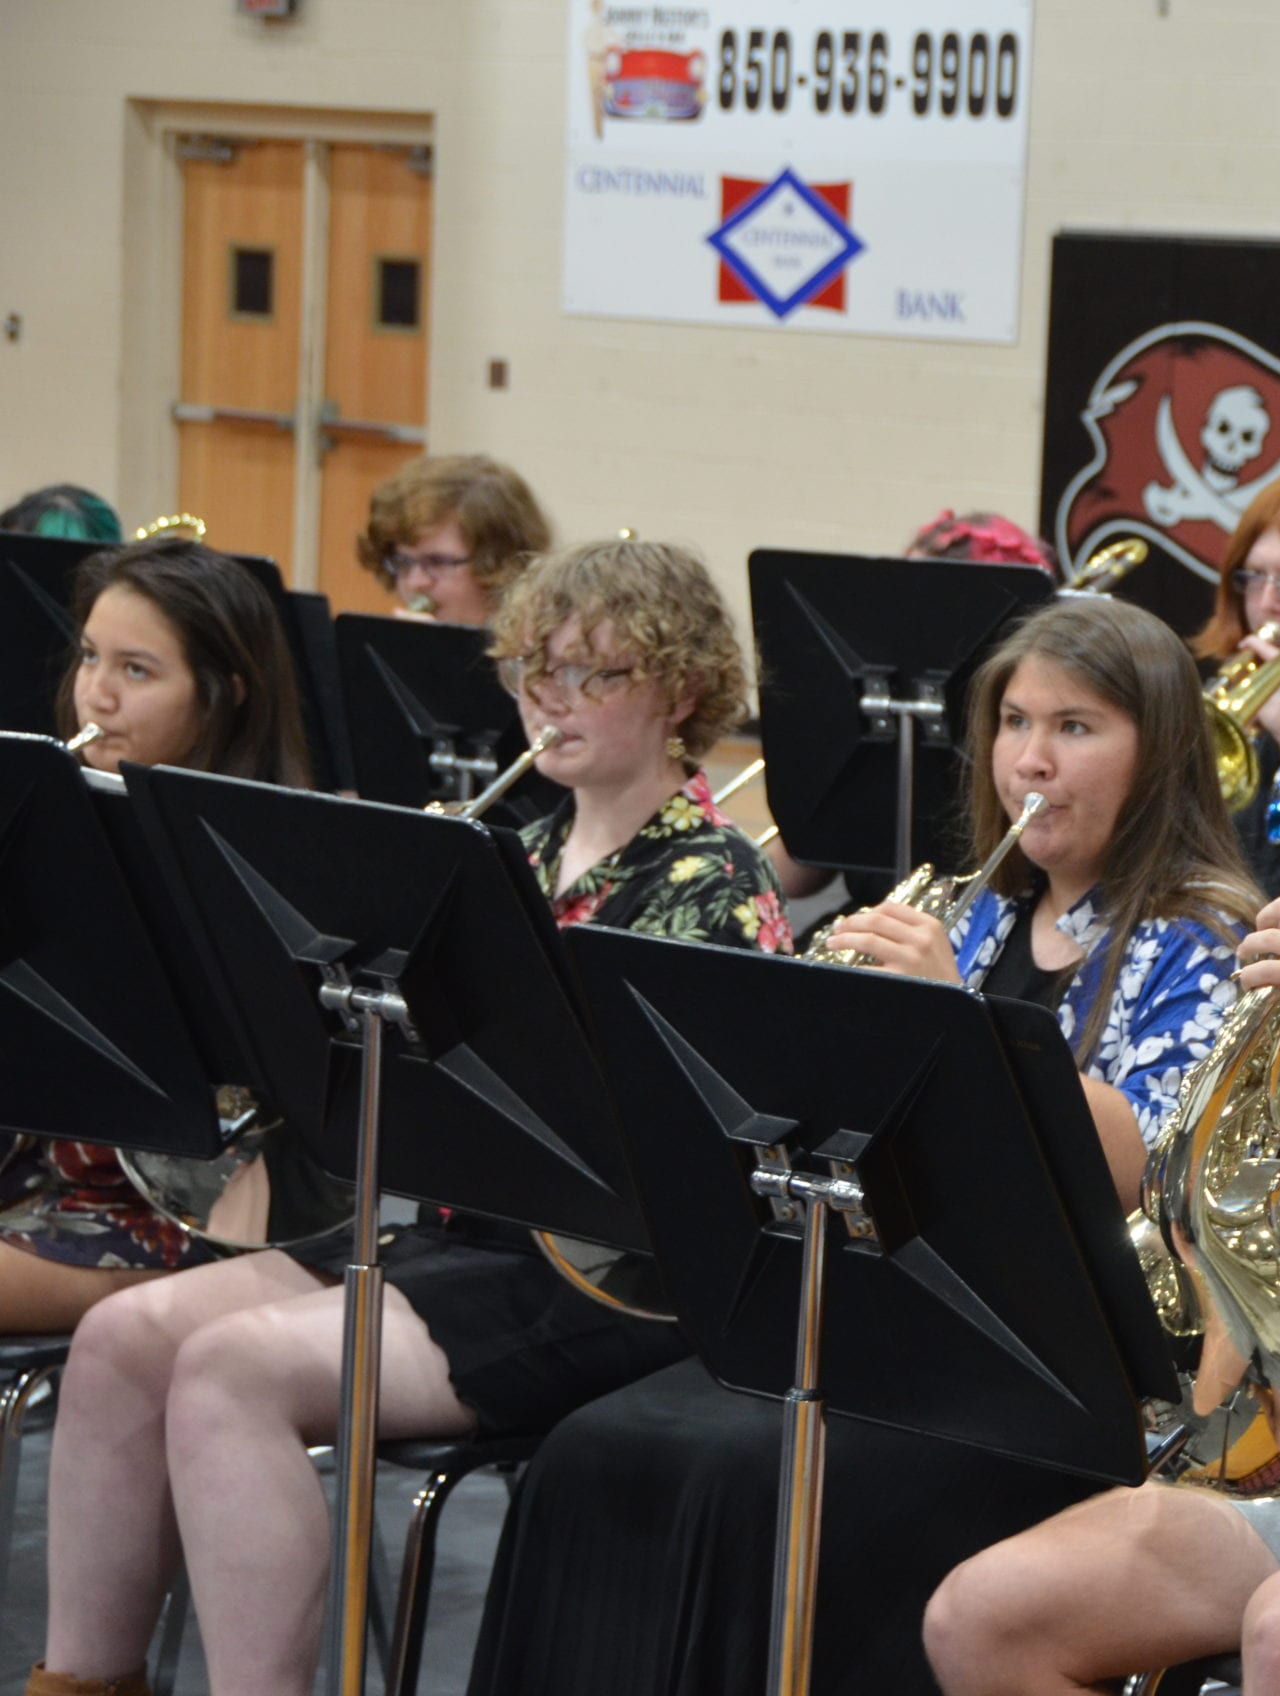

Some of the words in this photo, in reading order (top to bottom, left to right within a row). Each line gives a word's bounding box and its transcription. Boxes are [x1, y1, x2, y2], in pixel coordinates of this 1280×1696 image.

[718, 29, 1018, 118] 850-936-9900
[576, 164, 707, 200] CENTENNIAL
[895, 287, 967, 323] BANK
